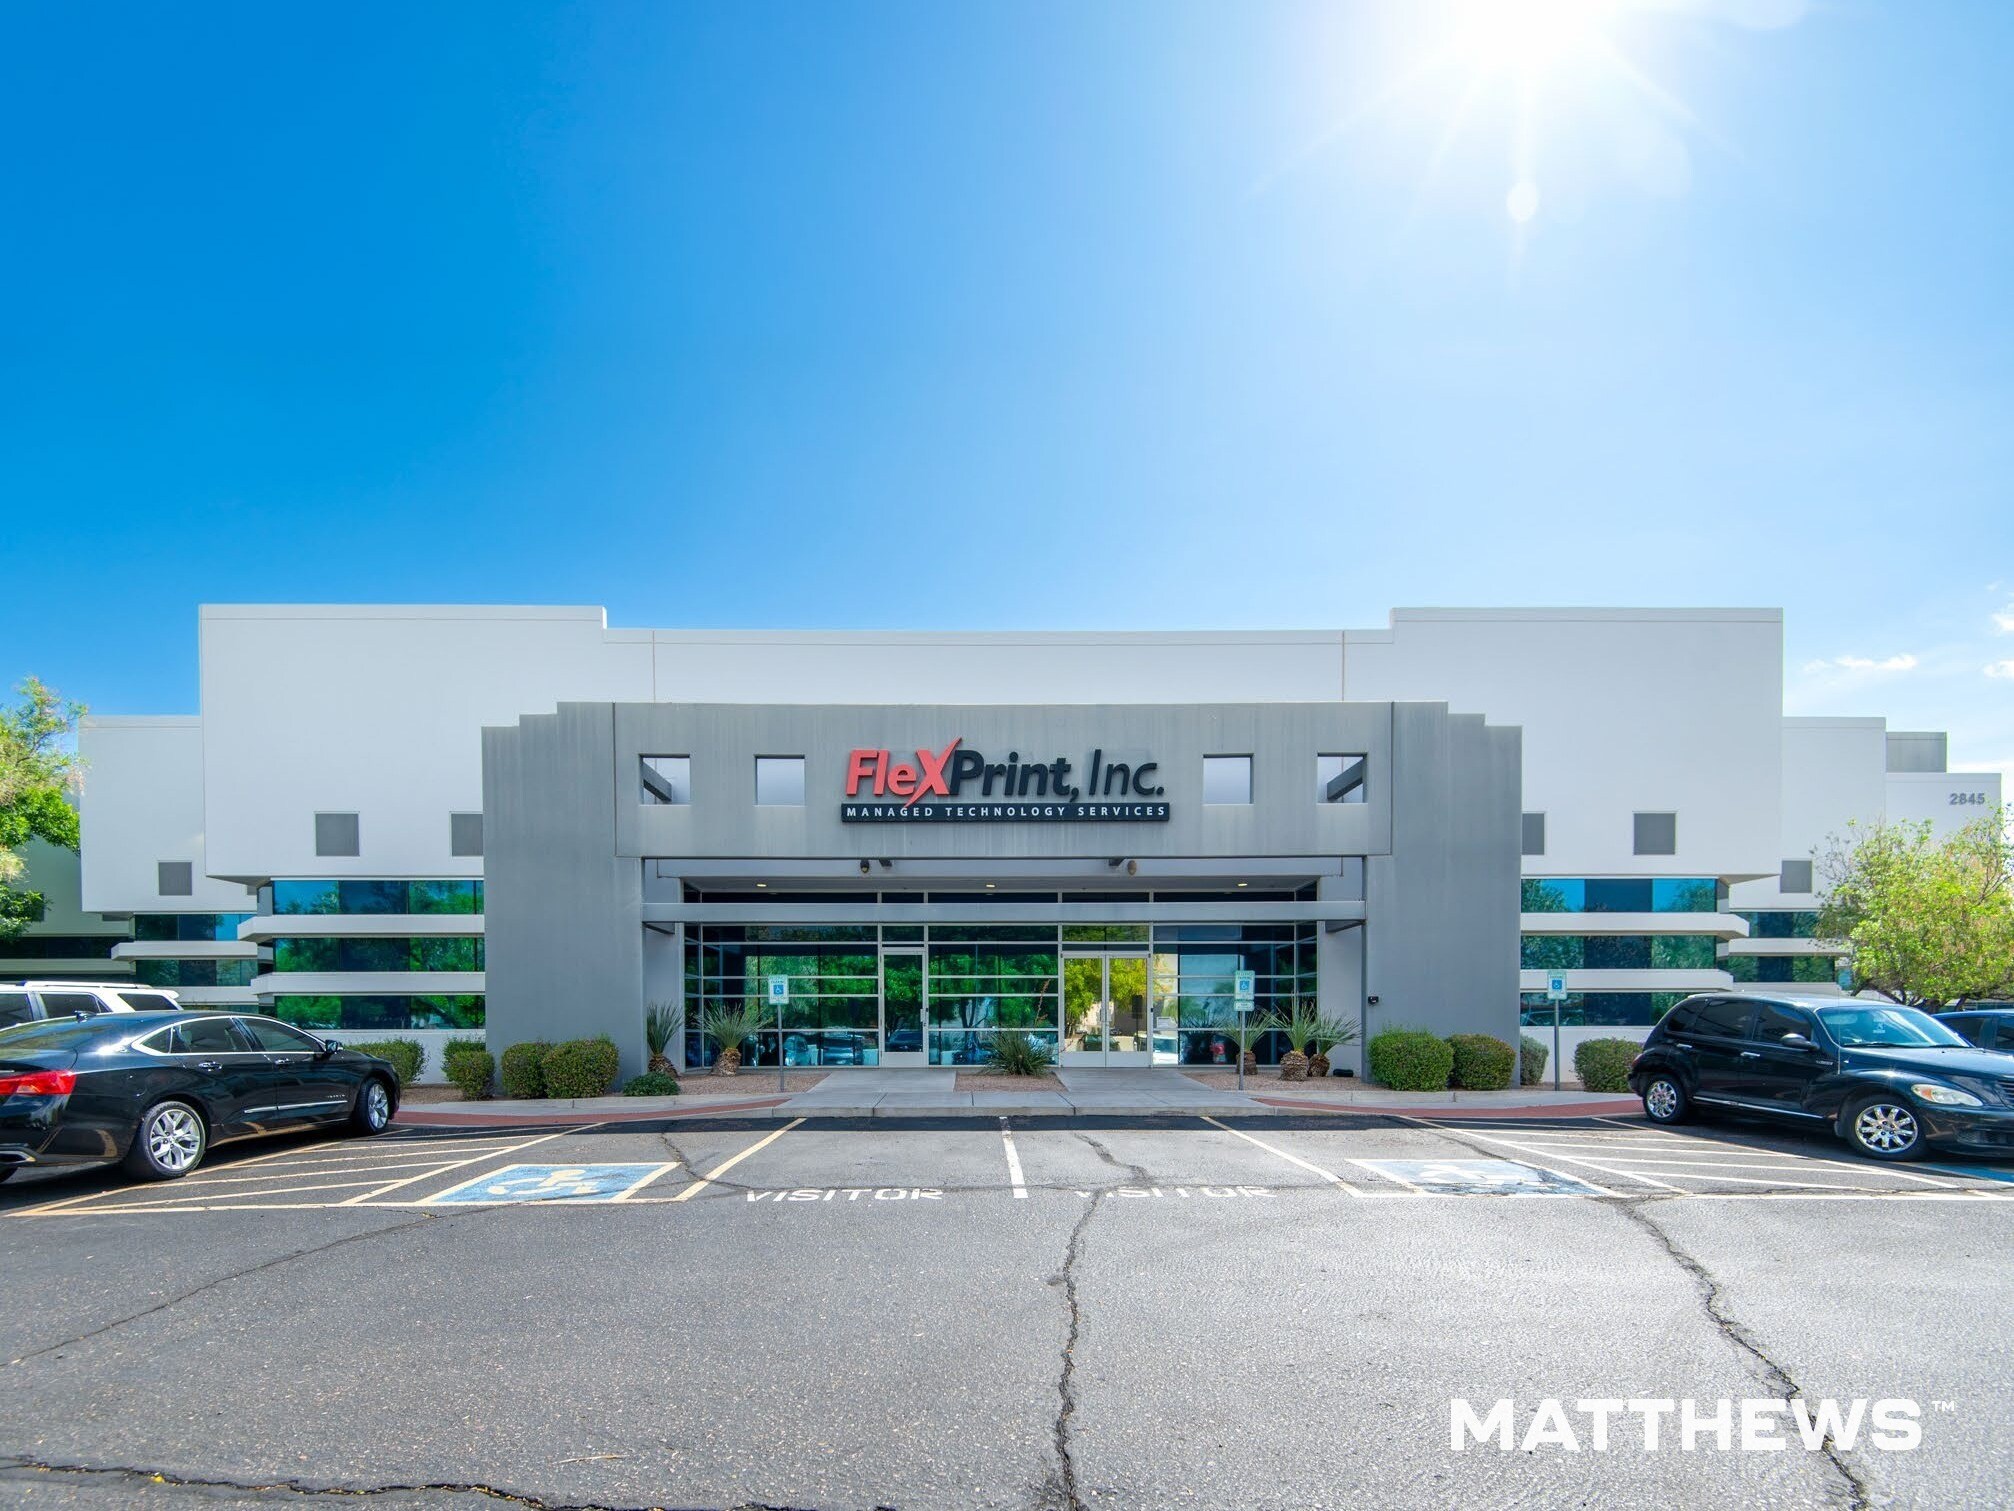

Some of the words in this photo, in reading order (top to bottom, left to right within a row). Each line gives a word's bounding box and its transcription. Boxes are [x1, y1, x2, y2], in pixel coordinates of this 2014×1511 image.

[1089, 748, 1165, 796] Inc.
[1949, 792, 1985, 805] 2845
[846, 806, 933, 817] MANAGED
[946, 806, 1065, 817] TECHNOLOGY
[1078, 806, 1165, 817] SERVICES
[746, 1187, 944, 1202] VISITOR
